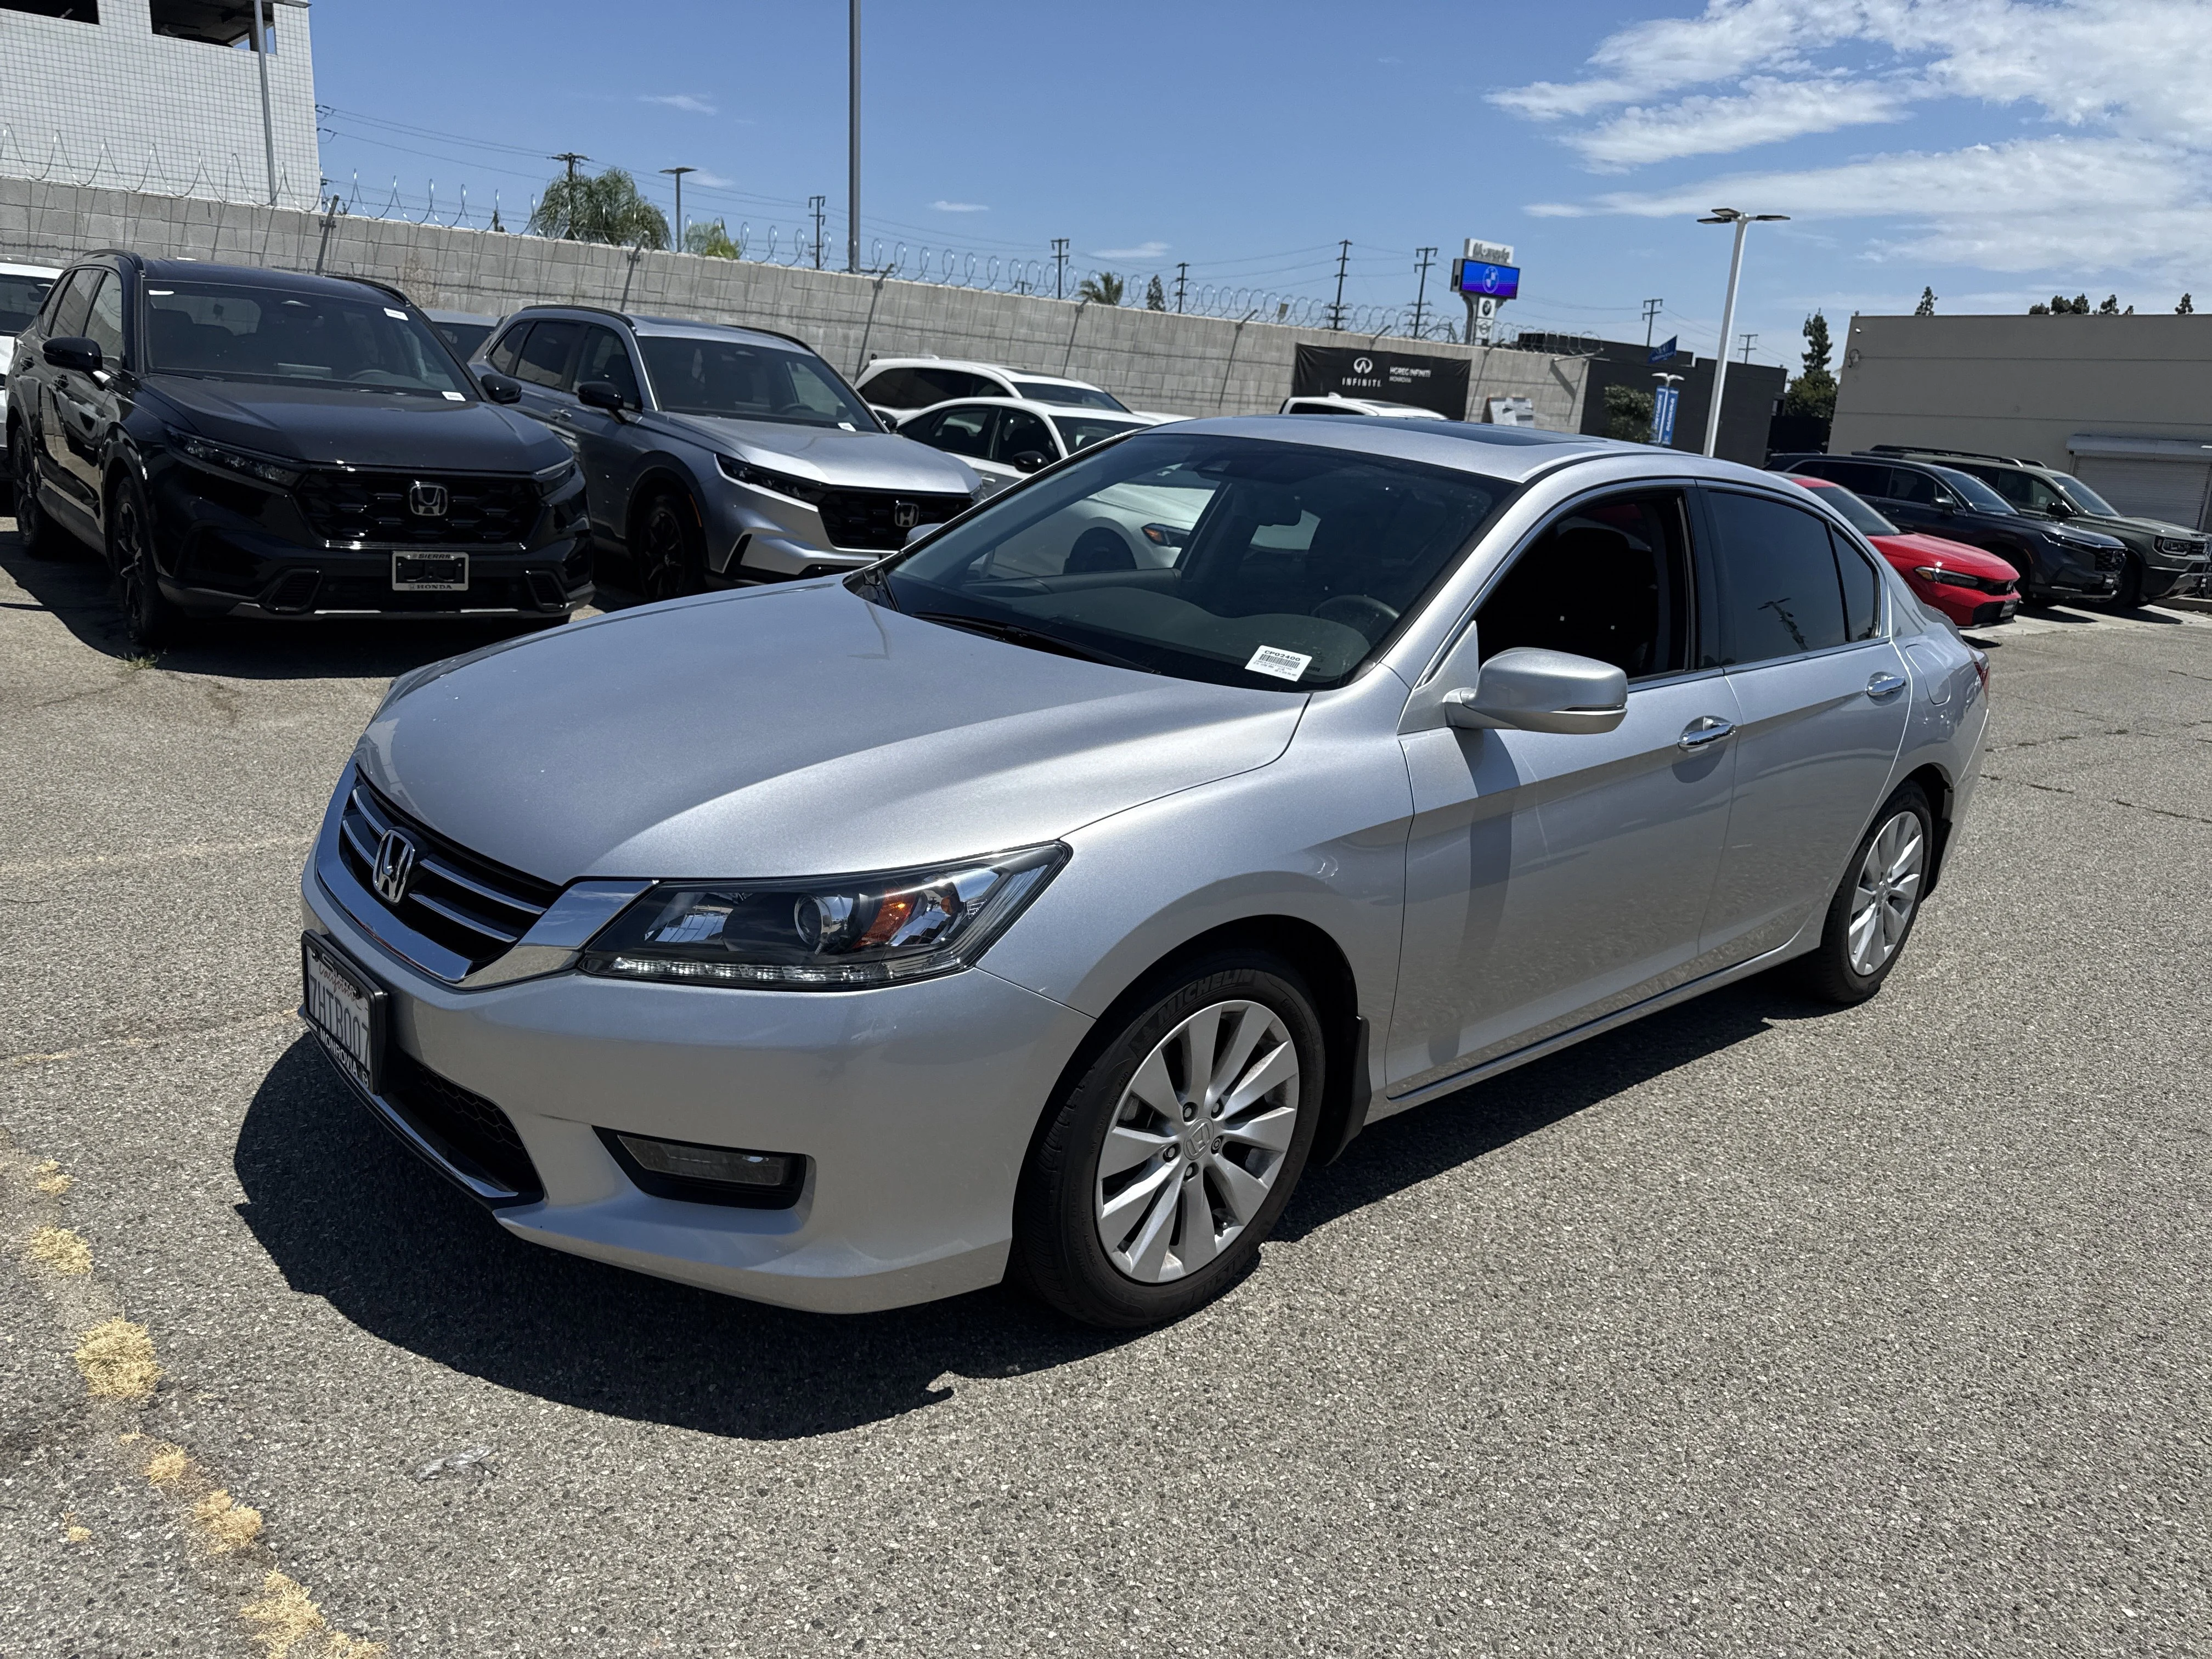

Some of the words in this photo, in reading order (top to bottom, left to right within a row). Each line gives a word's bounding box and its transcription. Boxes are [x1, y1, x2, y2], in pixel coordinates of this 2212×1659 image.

[1342, 377, 1382, 387] INFINITI
[1264, 650, 1301, 662] CP02400
[309, 974, 370, 1068] 7HTB007
[1158, 969, 1256, 1025] MICHELIN
[320, 1028, 358, 1077] MONROVIA
